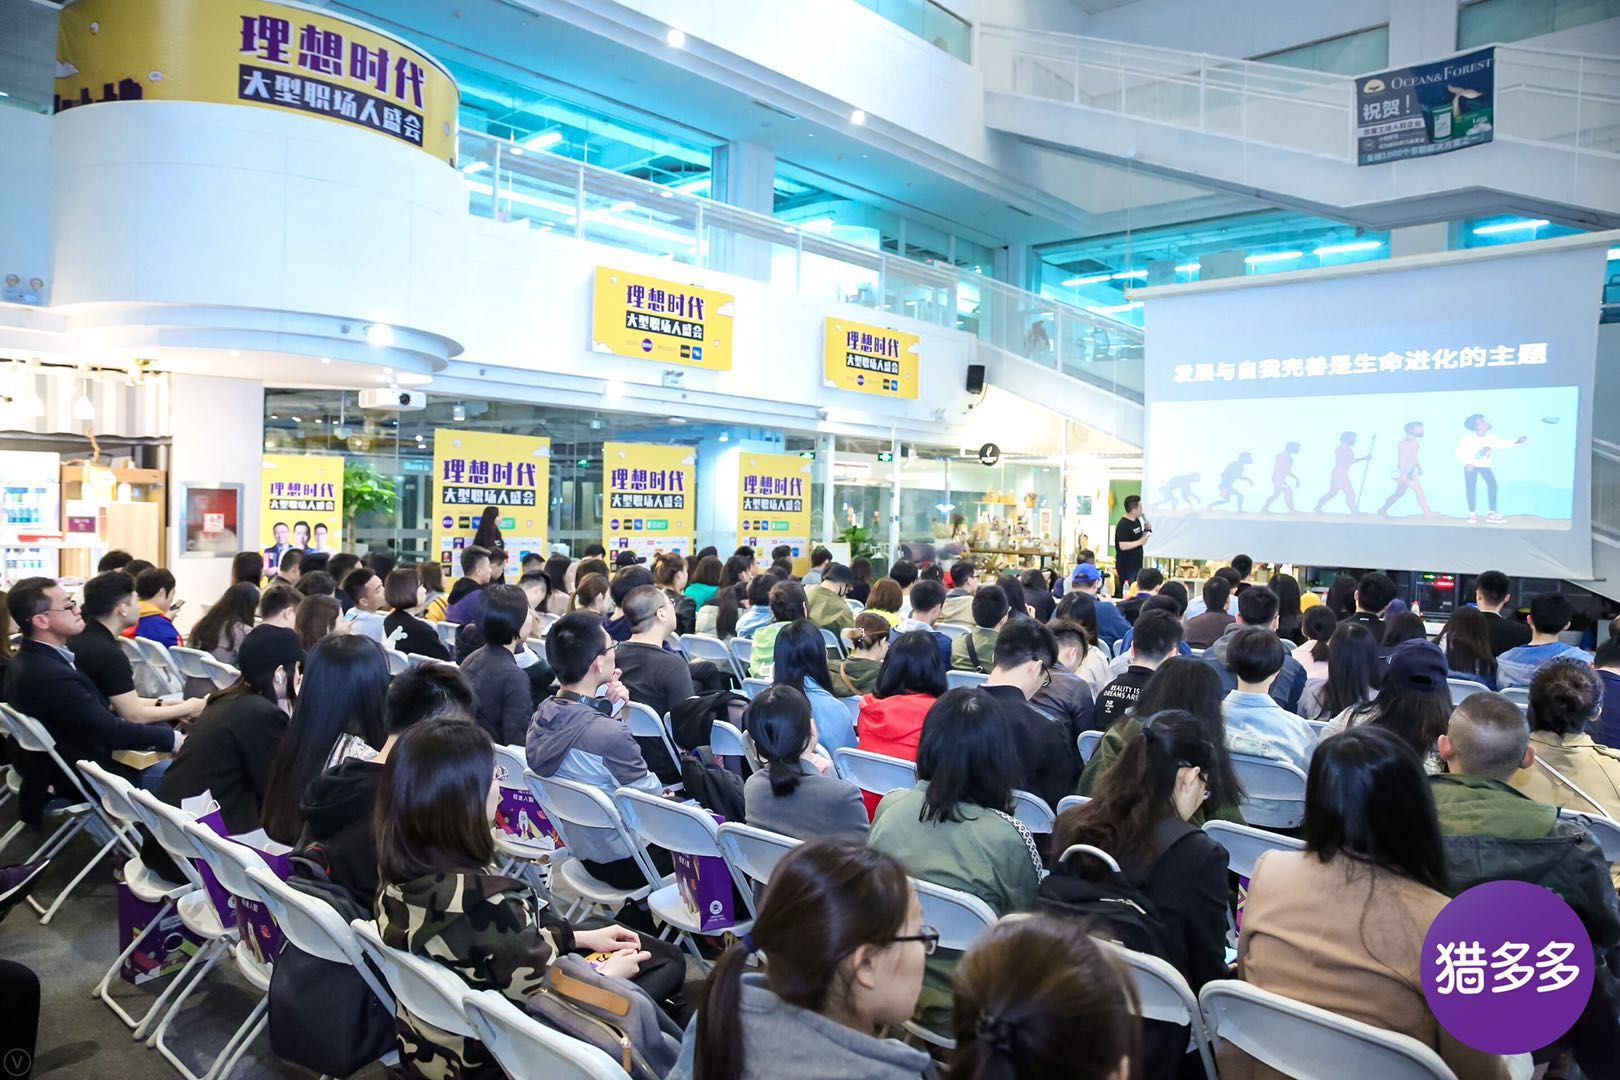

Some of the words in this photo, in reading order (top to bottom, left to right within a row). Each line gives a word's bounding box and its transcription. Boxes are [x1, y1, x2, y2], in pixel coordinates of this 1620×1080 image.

[239, 15, 425, 109] 理想时代
[242, 70, 423, 142] 大型职场人盛会
[626, 285, 705, 321] 理想时代
[627, 311, 703, 340] 大型职场人盛会
[847, 331, 900, 358] 理想时代
[847, 354, 899, 374] 大型职场人盛会
[1173, 343, 1548, 383] 发展与自我完善是生命进化的主题
[443, 459, 536, 487] 理想时代
[611, 468, 684, 491] 理想时代
[270, 481, 334, 498] 理想时代
[443, 488, 535, 506] 大型职场人盛会
[743, 475, 802, 497] 理想时代
[270, 500, 334, 511] 大型职场人盛会
[611, 494, 683, 509] 大型职场人盛会
[744, 497, 802, 512] 大型职场人盛会
[1103, 690, 1126, 699] DREAMS
[1110, 684, 1133, 693] REALITY
[1133, 687, 1140, 695] IS
